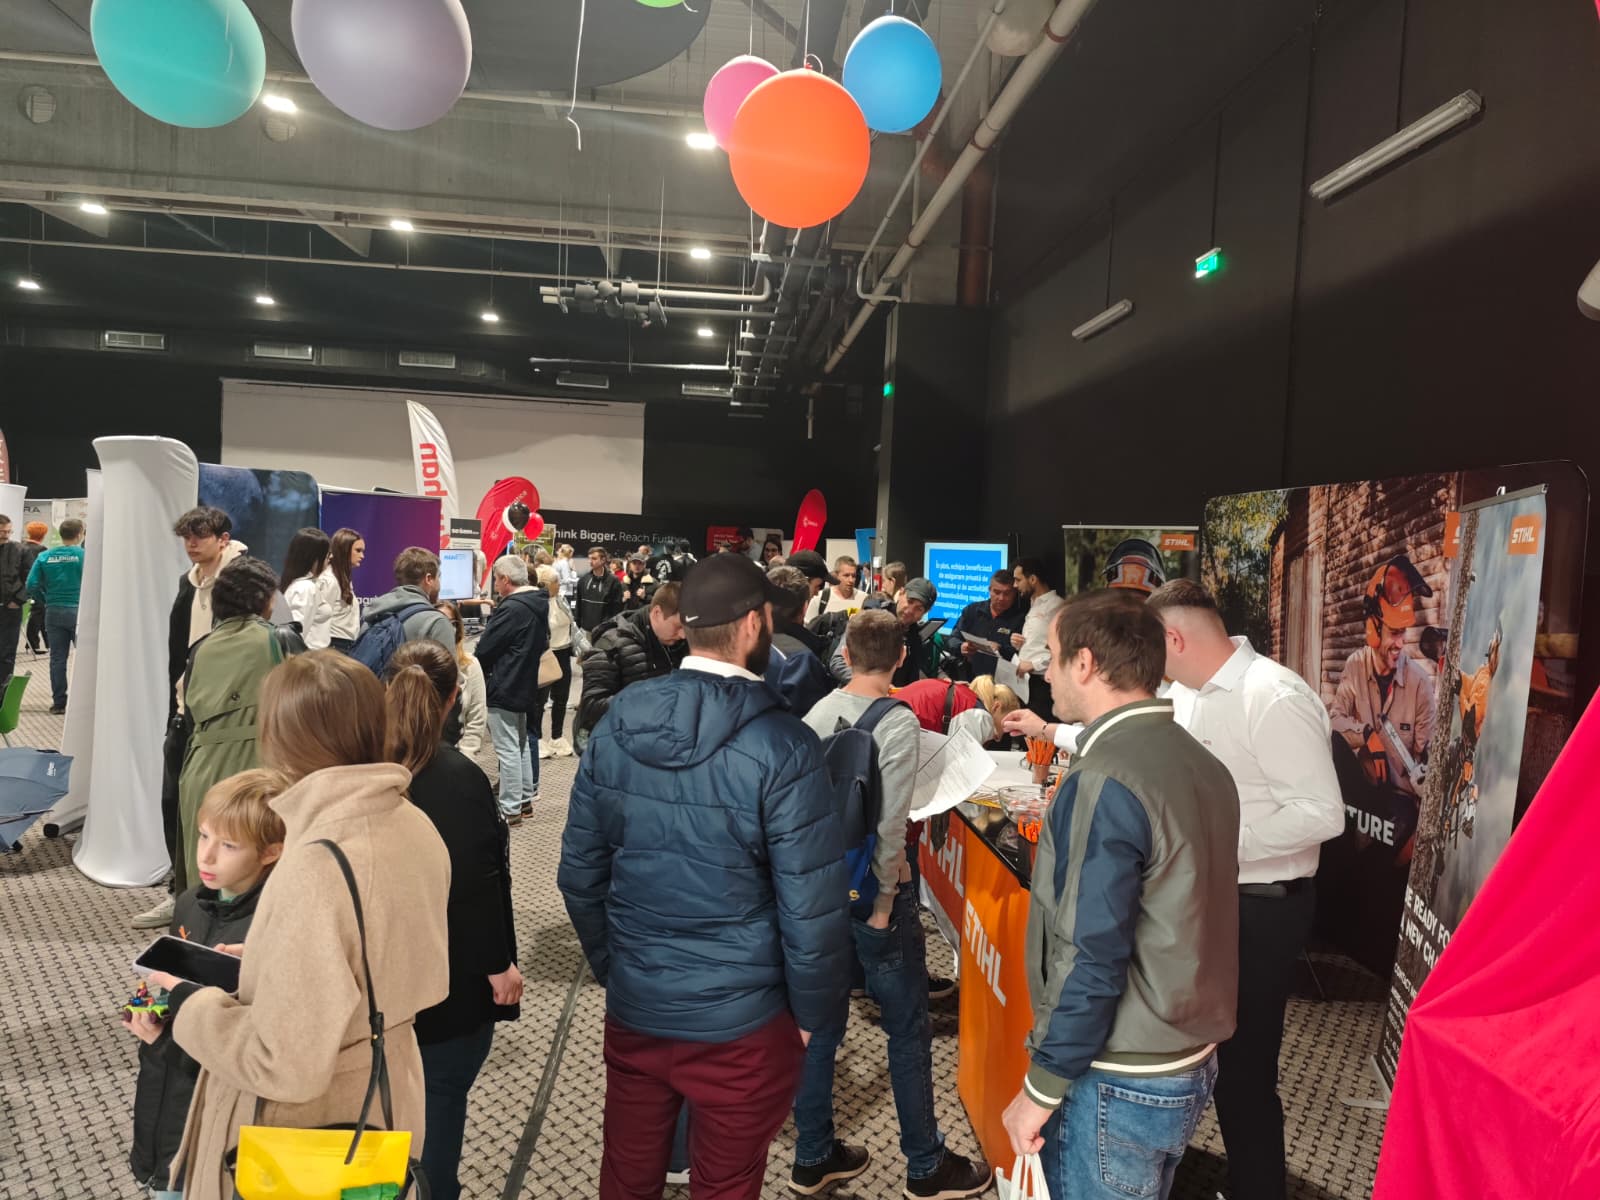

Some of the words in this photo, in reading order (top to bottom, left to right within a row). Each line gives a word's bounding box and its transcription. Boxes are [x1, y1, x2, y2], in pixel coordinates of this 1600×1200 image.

[555, 529, 578, 540] hink
[580, 529, 617, 543] Bigger.
[619, 531, 650, 542] Reach
[1164, 538, 1191, 546] STIHL
[1512, 526, 1535, 544] STIHL
[1346, 804, 1395, 847] TURE
[1405, 918, 1424, 953] NEW
[1414, 894, 1438, 937] READY
[1438, 922, 1451, 950] FO
[964, 898, 1007, 1008] STIHL
